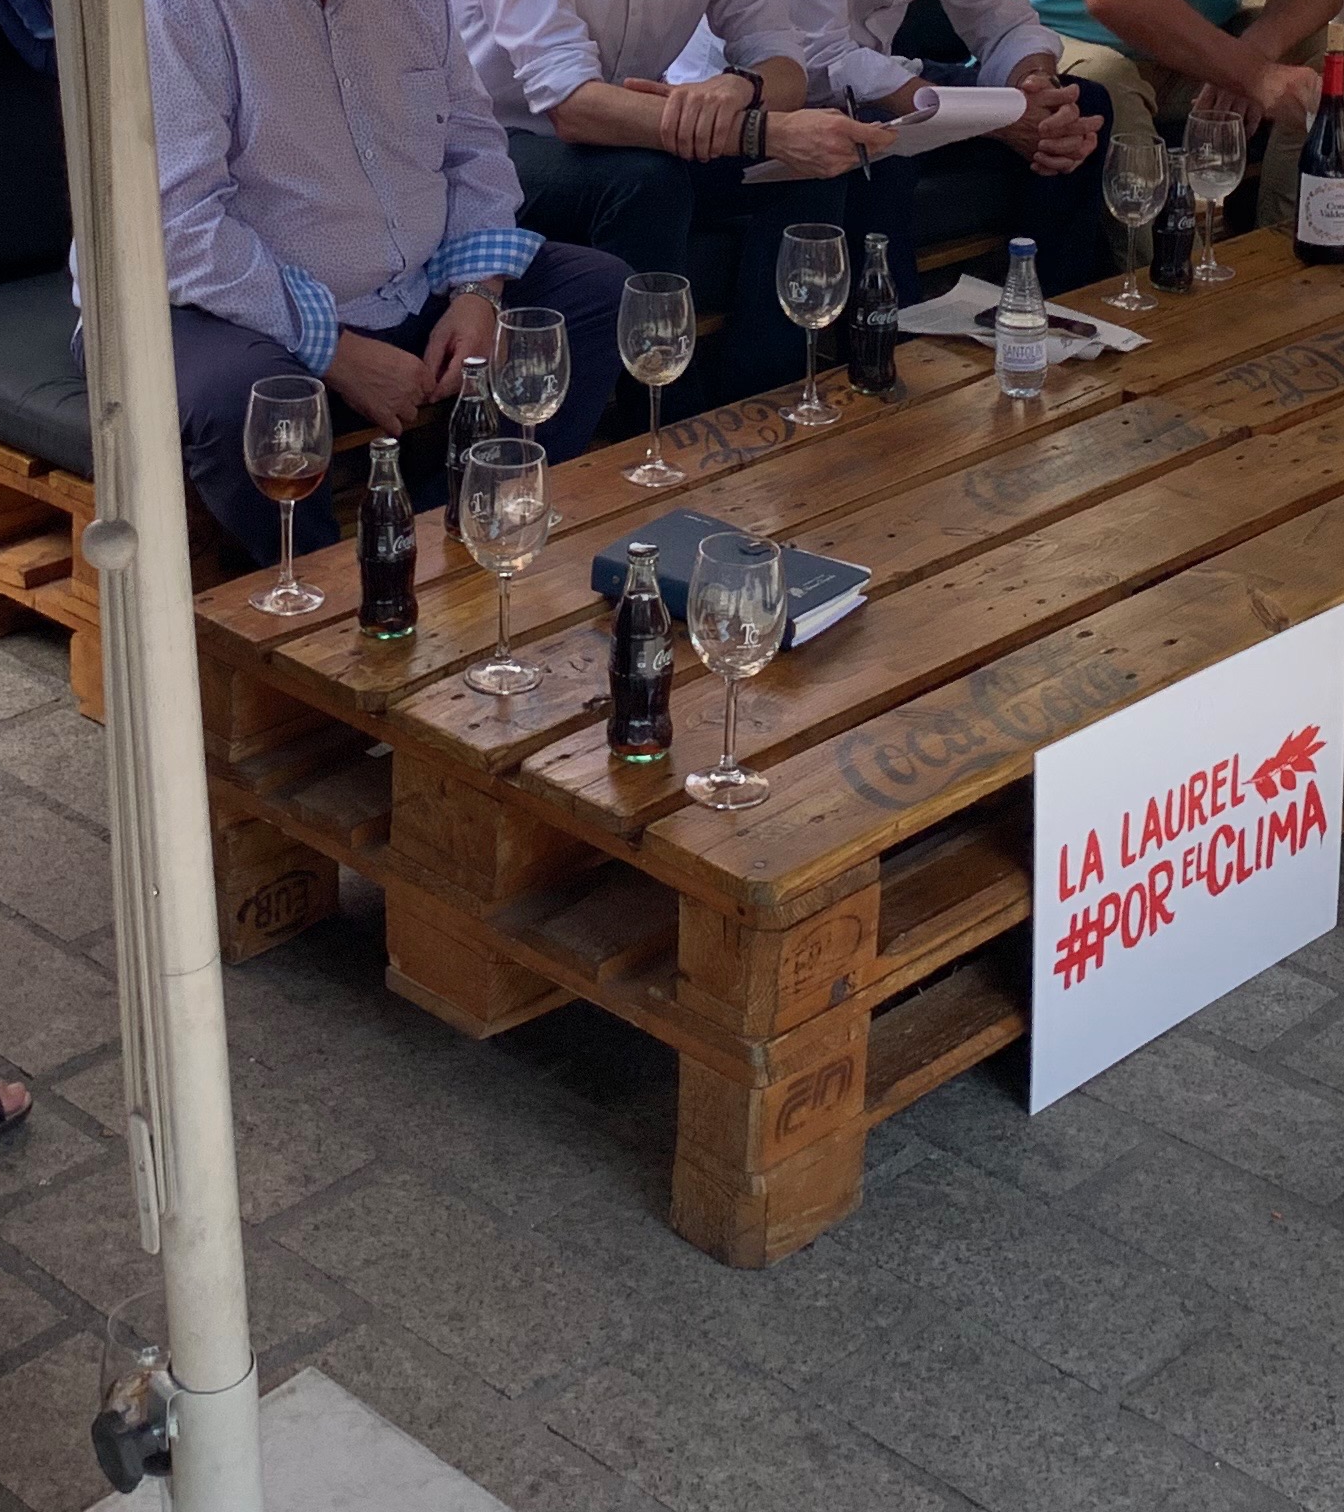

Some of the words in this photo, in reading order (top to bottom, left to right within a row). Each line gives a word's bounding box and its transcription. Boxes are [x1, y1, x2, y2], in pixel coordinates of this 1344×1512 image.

[1052, 859, 1176, 990] #POR
[1181, 841, 1209, 889] EL
[1205, 779, 1328, 898] CLIMA
[1058, 828, 1105, 903] LA
[1119, 752, 1246, 868] LAUREL
